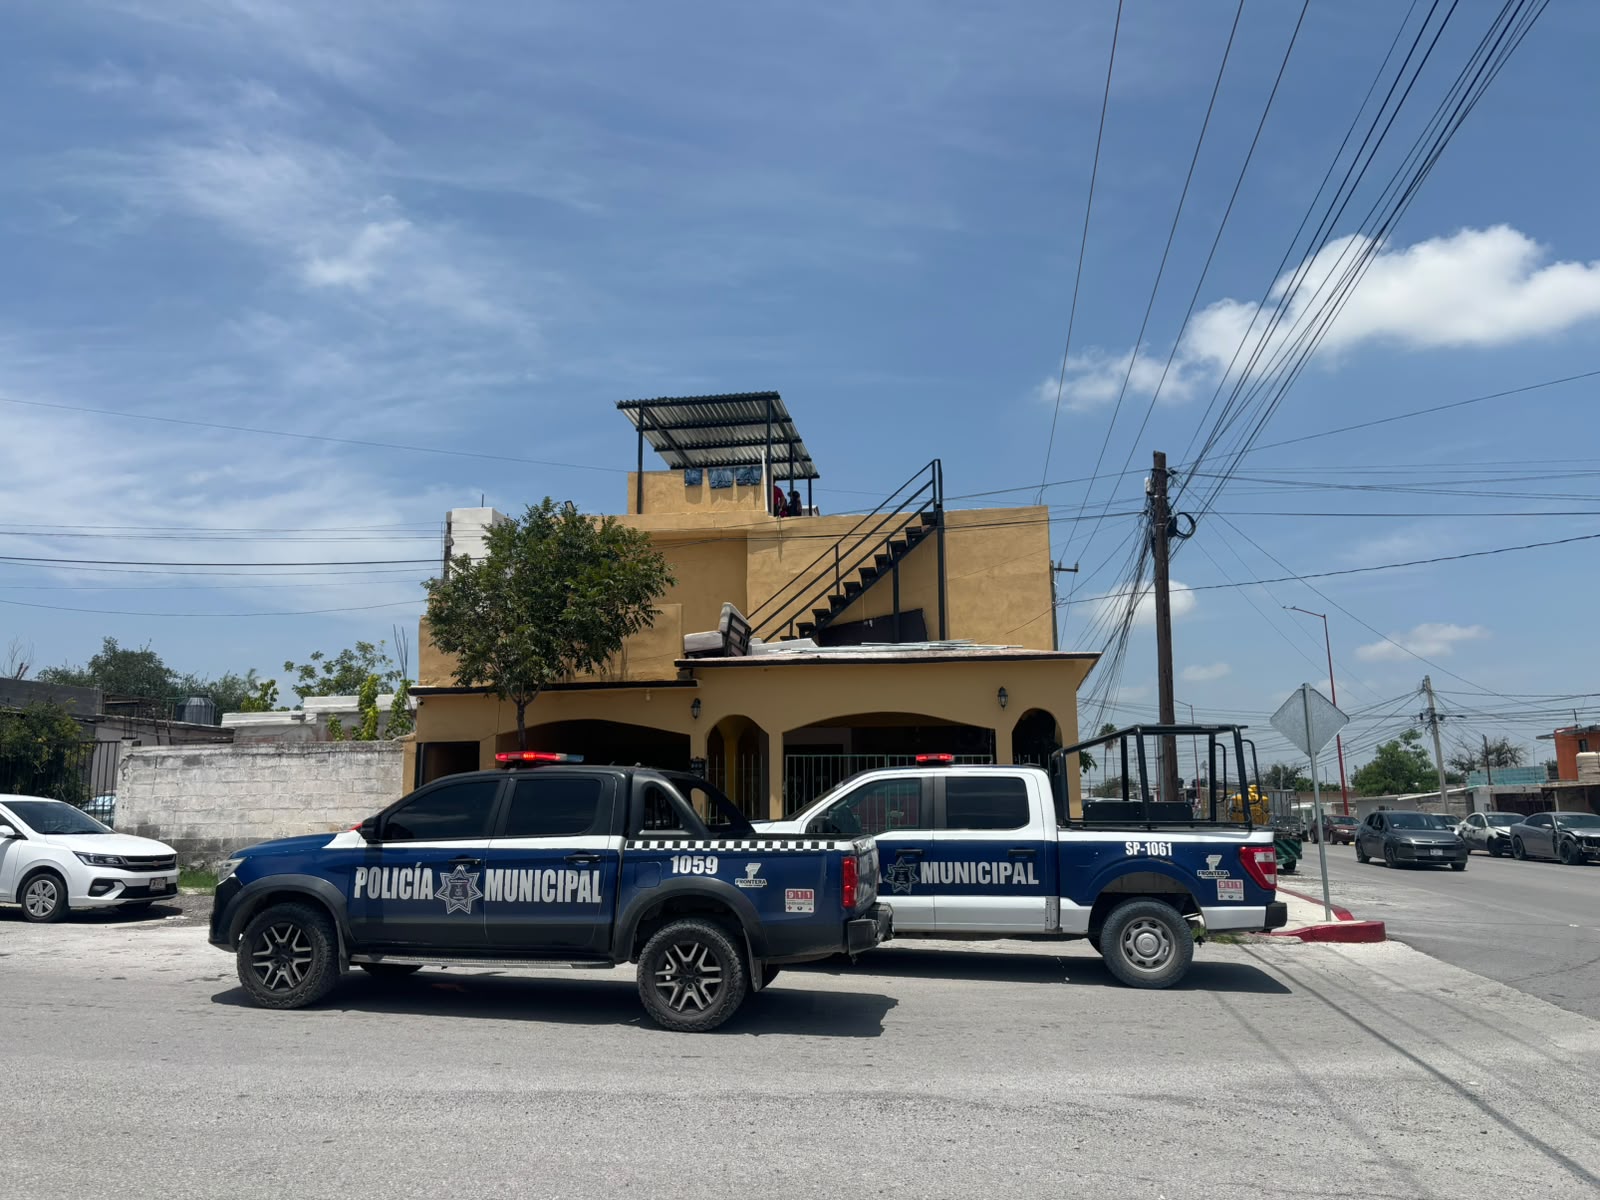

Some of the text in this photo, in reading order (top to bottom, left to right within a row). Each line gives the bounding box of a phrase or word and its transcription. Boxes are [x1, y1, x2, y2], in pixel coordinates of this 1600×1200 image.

[1125, 841, 1173, 856] SP-1061
[670, 855, 718, 875] 1059
[919, 861, 1040, 885] MUNICIPAL
[354, 862, 602, 903] POLICÍA MUNICIPAL
[787, 891, 811, 899] 911
